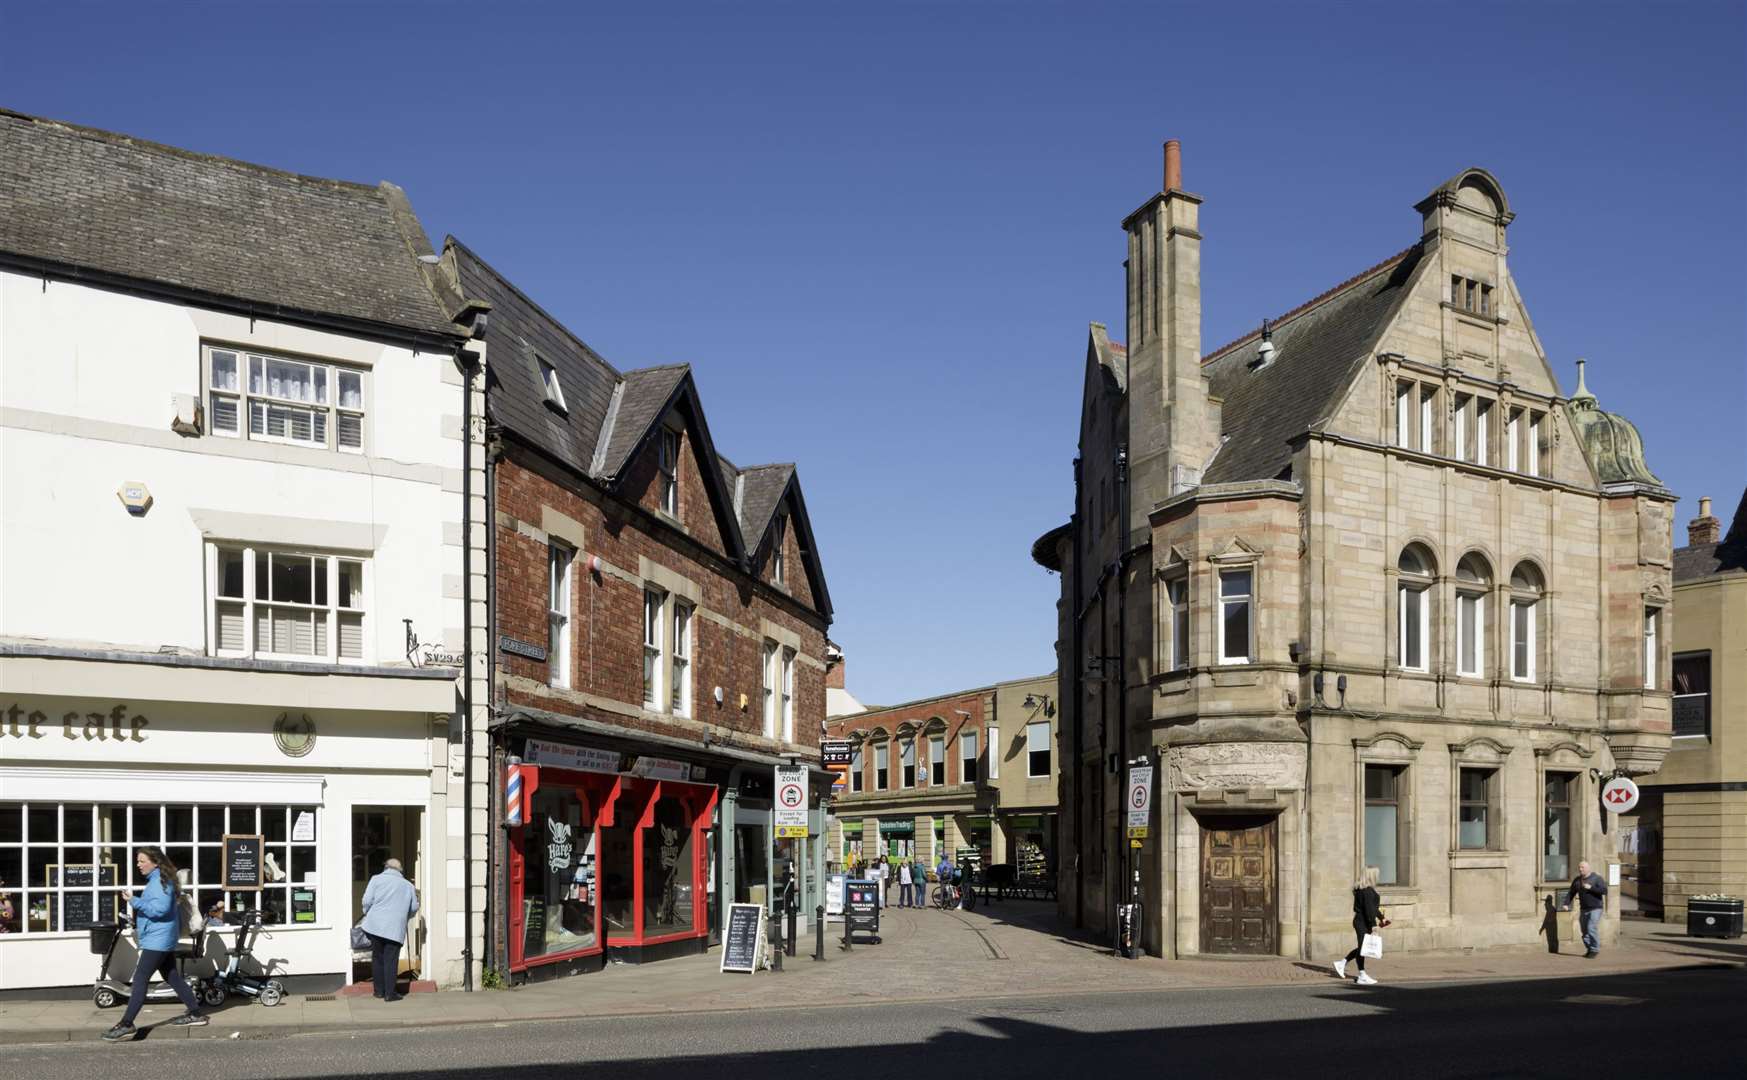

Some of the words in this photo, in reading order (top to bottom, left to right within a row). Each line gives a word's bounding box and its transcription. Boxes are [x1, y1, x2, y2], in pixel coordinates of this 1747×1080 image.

[0, 703, 47, 740] te
[63, 704, 149, 743] cafe
[547, 842, 573, 859] Hare's
